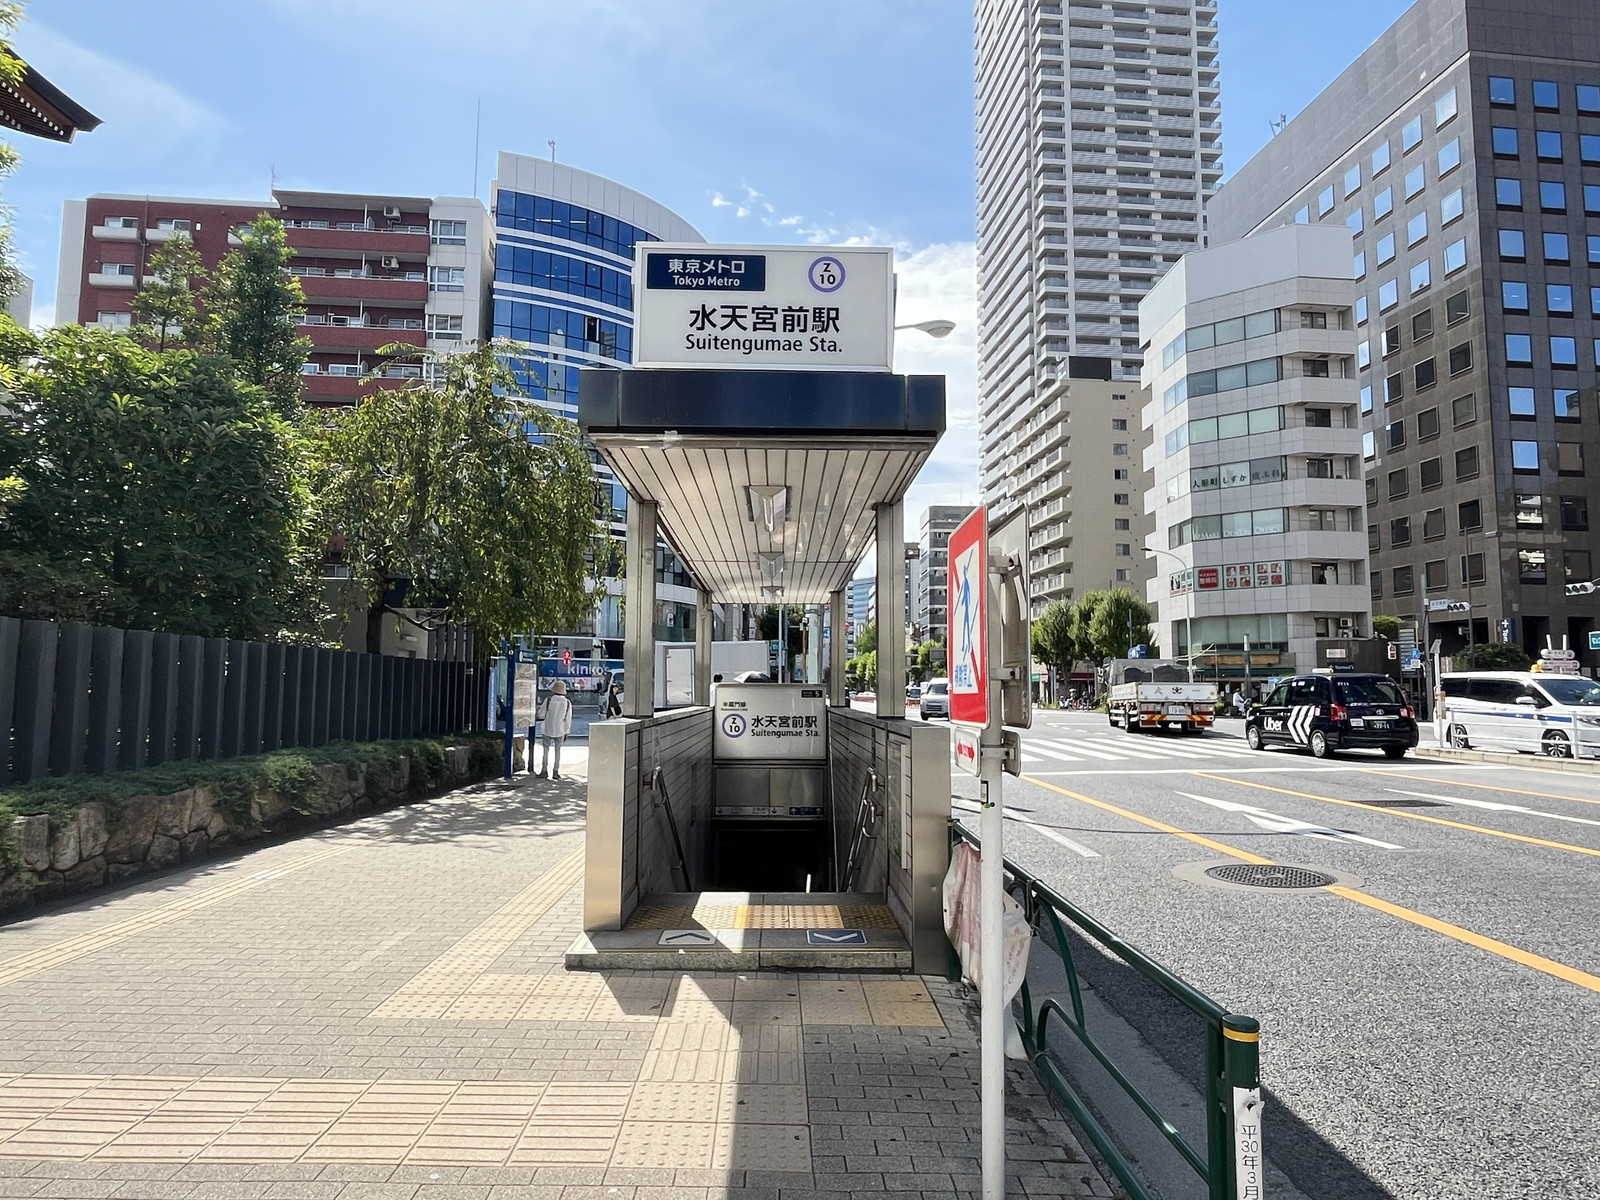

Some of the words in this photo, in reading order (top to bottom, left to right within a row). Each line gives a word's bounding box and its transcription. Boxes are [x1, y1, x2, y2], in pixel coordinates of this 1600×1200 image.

[668, 258, 745, 274] 東京メトロ
[823, 263, 832, 273] Z
[672, 275, 705, 288] Tokyo
[707, 276, 740, 287] Metro
[819, 274, 836, 285] 10
[689, 303, 840, 334] 水天宮前駅
[685, 333, 803, 355] Suitengumae
[809, 336, 843, 353] Sta.
[731, 717, 737, 725] Z
[751, 715, 818, 728] 水天宮前駅
[1263, 716, 1284, 731] Uber
[729, 725, 741, 733] 10
[751, 728, 803, 738] Suitengumae
[805, 729, 821, 737] Sta.
[1240, 1124, 1260, 1200] 平30年3月
